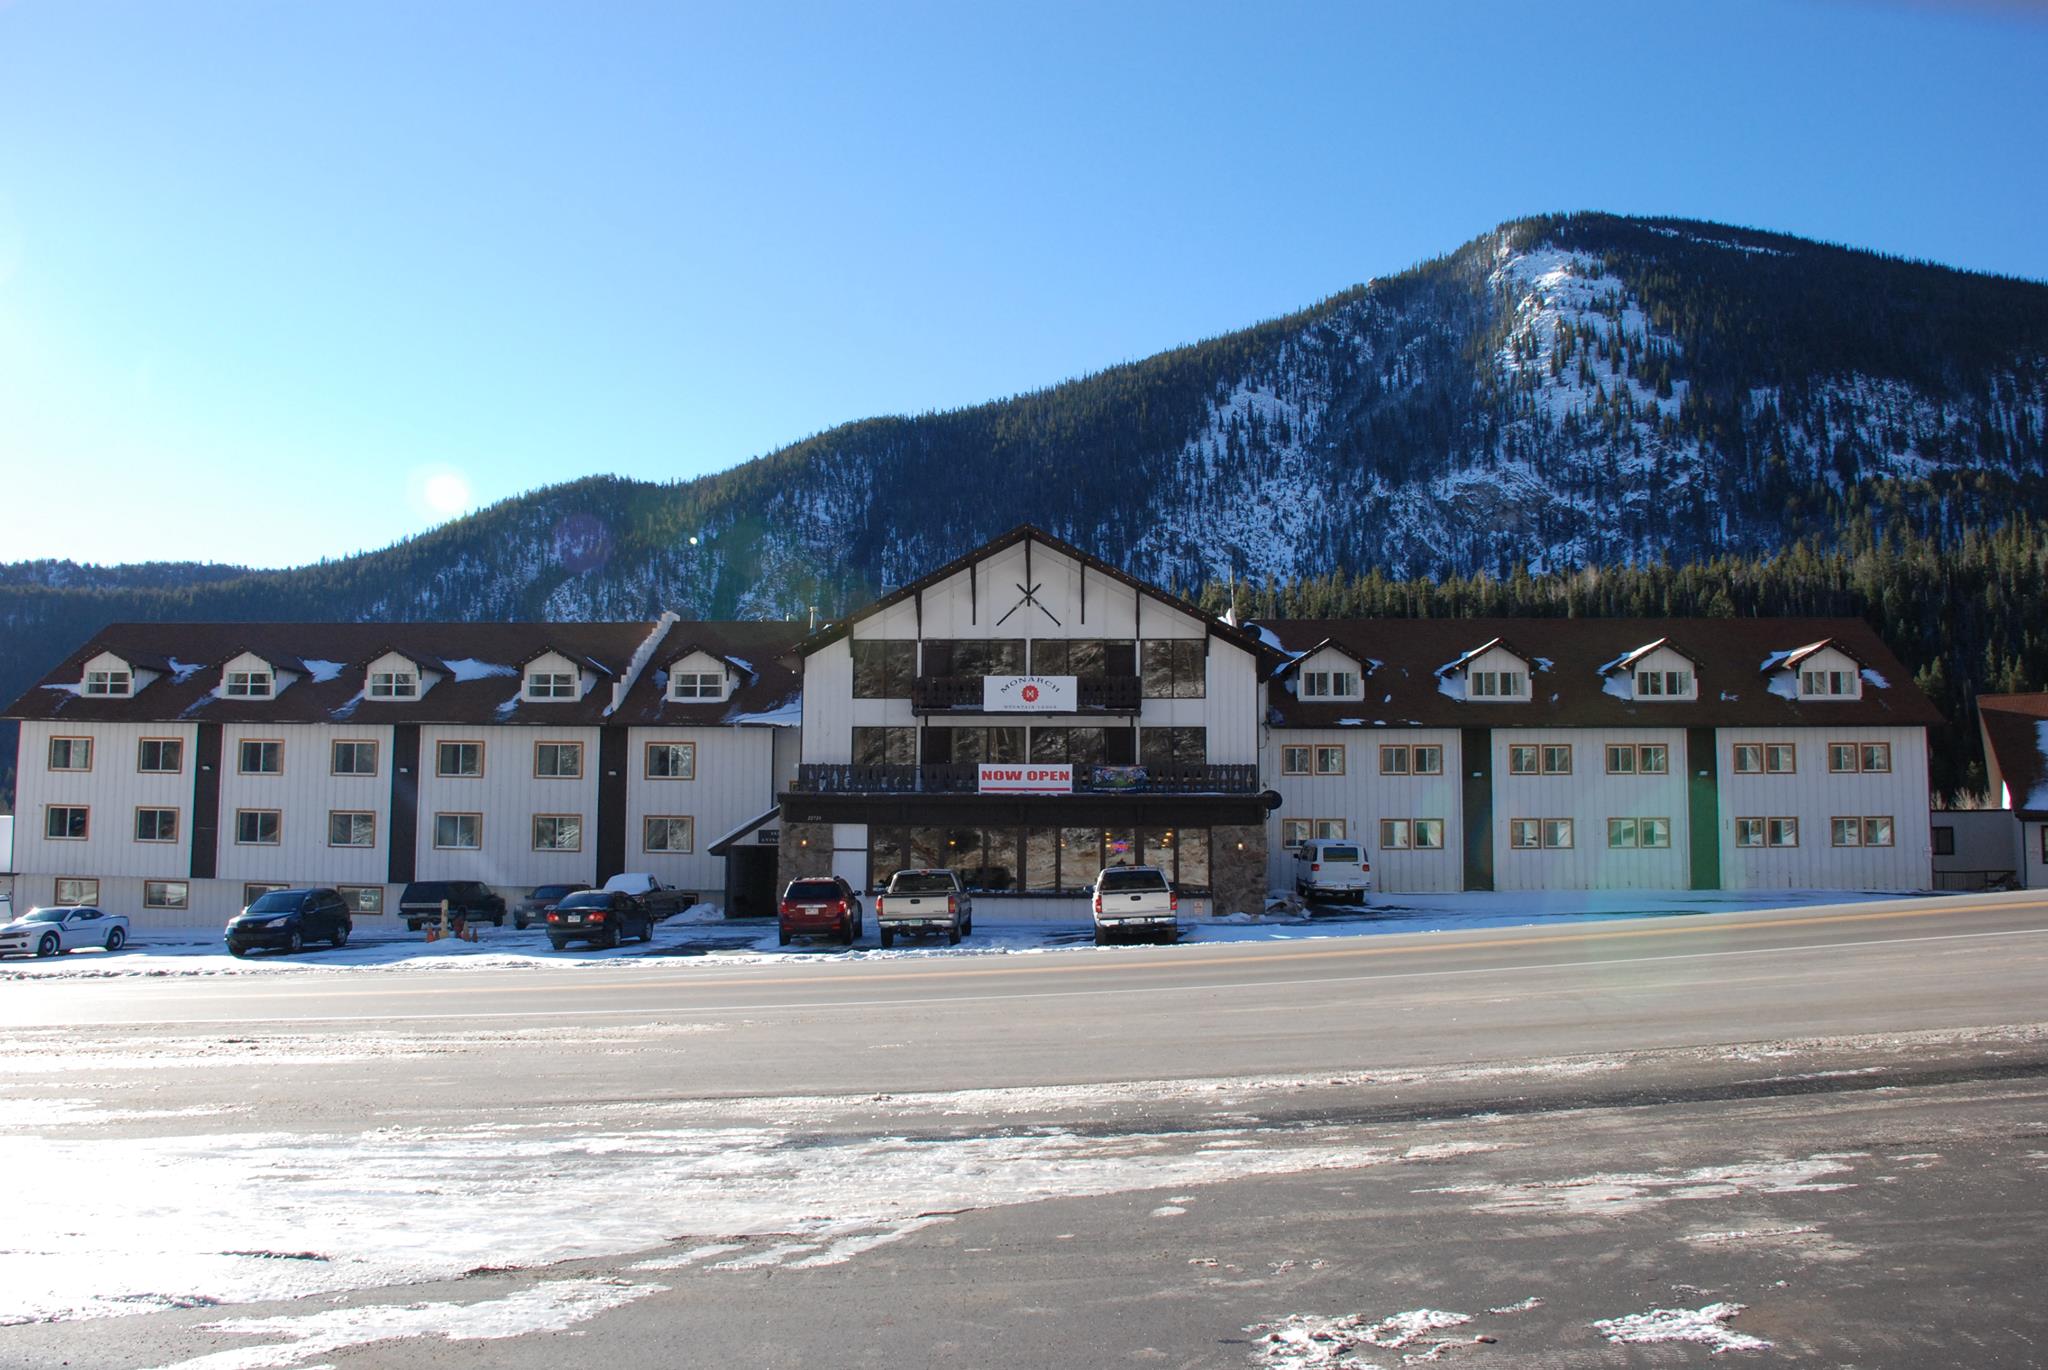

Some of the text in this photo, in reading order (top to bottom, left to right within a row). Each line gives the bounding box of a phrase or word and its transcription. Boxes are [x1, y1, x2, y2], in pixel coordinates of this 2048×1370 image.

[1000, 677, 1061, 694] MONARCH
[981, 770, 1070, 781] NOW OPEN
